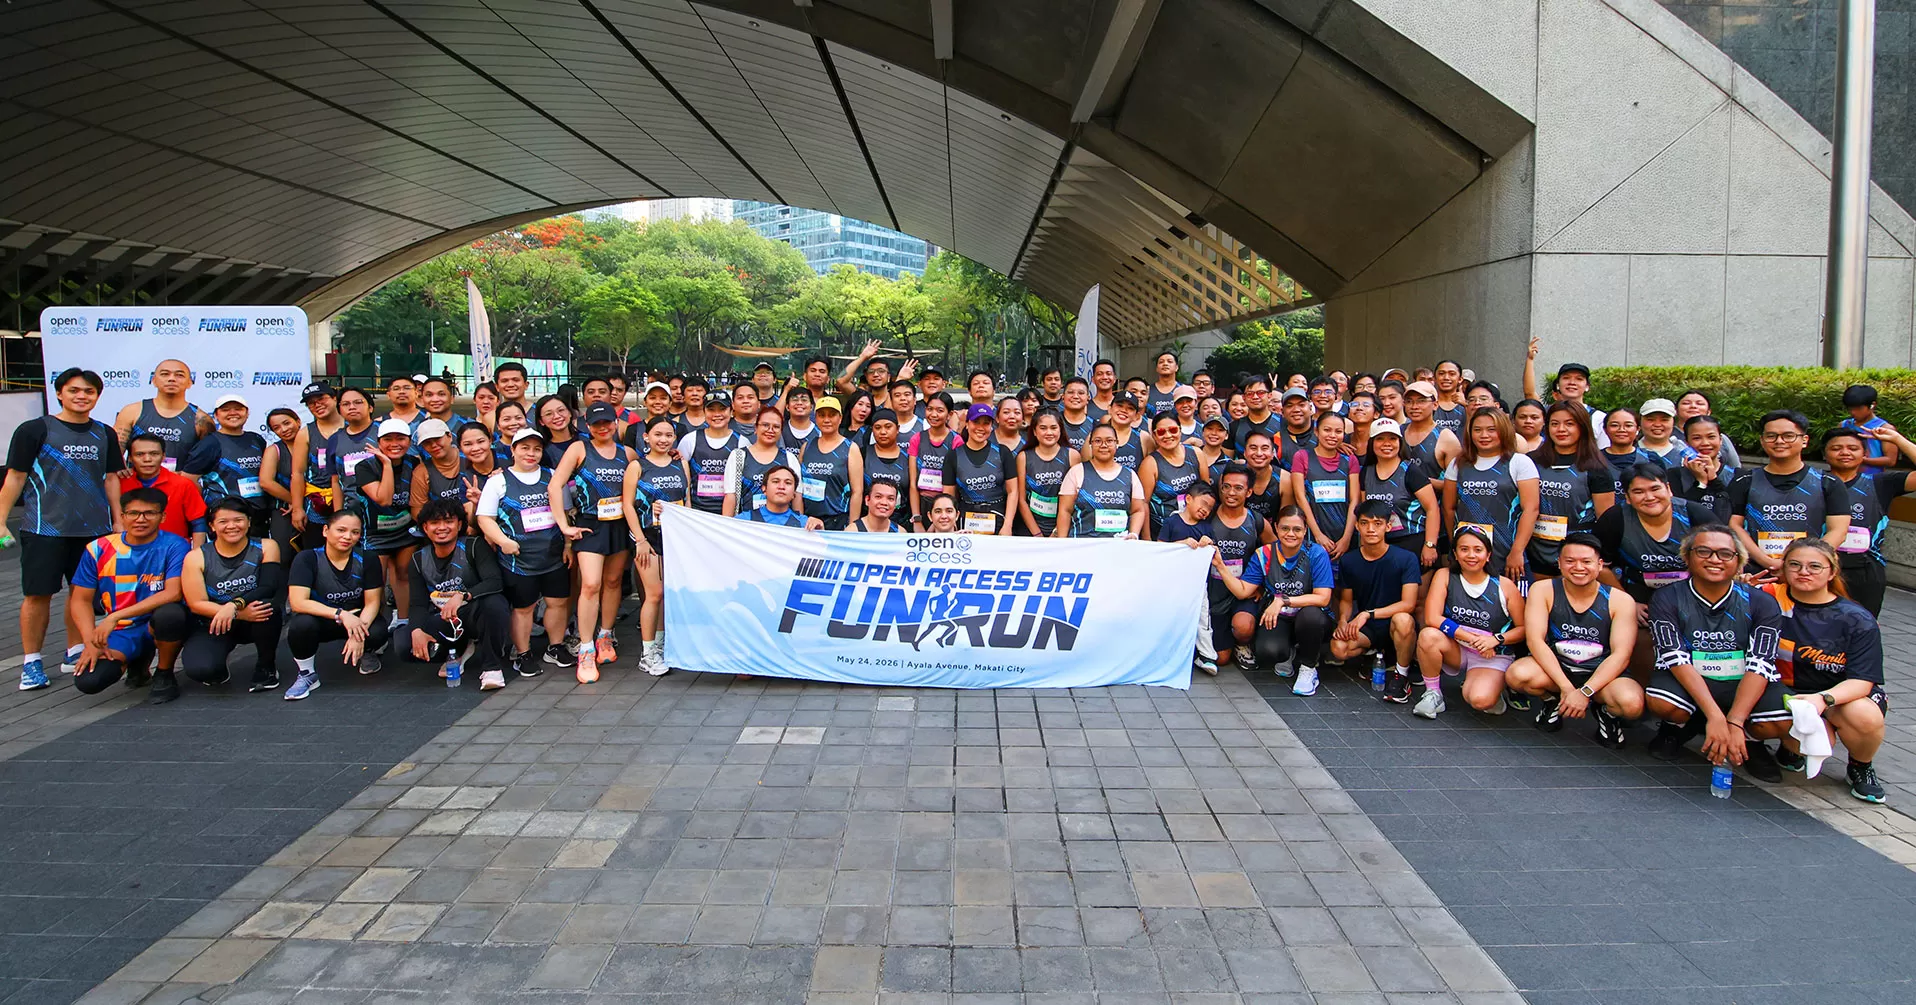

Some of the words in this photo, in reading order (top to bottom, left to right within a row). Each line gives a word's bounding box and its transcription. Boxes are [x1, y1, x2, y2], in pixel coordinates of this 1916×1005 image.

[51, 318, 77, 327] open
[152, 318, 179, 327] open
[256, 318, 284, 327] open
[103, 371, 130, 380] open
[205, 371, 232, 380] open
[63, 445, 90, 454] open
[596, 468, 619, 477] open
[1035, 472, 1055, 480] open
[966, 476, 988, 485] open
[1171, 475, 1191, 485] open
[968, 482, 996, 491] access
[1462, 481, 1487, 489] open
[520, 493, 543, 502] open
[1095, 491, 1116, 499] open
[1540, 488, 1570, 498] ccess
[521, 500, 548, 508] acces
[1763, 504, 1794, 513] open
[1763, 513, 1807, 521] access
[907, 538, 953, 550] open
[1218, 540, 1238, 549] open
[906, 552, 972, 564] access
[844, 562, 920, 586] OPEN
[924, 568, 1033, 592] ACCESS
[1036, 572, 1093, 594] BPO
[217, 578, 246, 589] open
[327, 591, 354, 600] open
[778, 580, 931, 644] FUN
[946, 592, 1090, 651] RUN
[1452, 606, 1479, 618] open
[1452, 614, 1489, 628] access
[1562, 623, 1588, 634] open
[1693, 630, 1724, 640] open
[1692, 640, 1737, 650] access
[1798, 646, 1847, 665] Manila
[836, 656, 855, 665] May
[858, 657, 872, 666] 24,
[875, 658, 898, 667] 2026
[907, 661, 932, 670] Ayala
[936, 662, 971, 671] Avenue,
[1007, 665, 1025, 673] City
